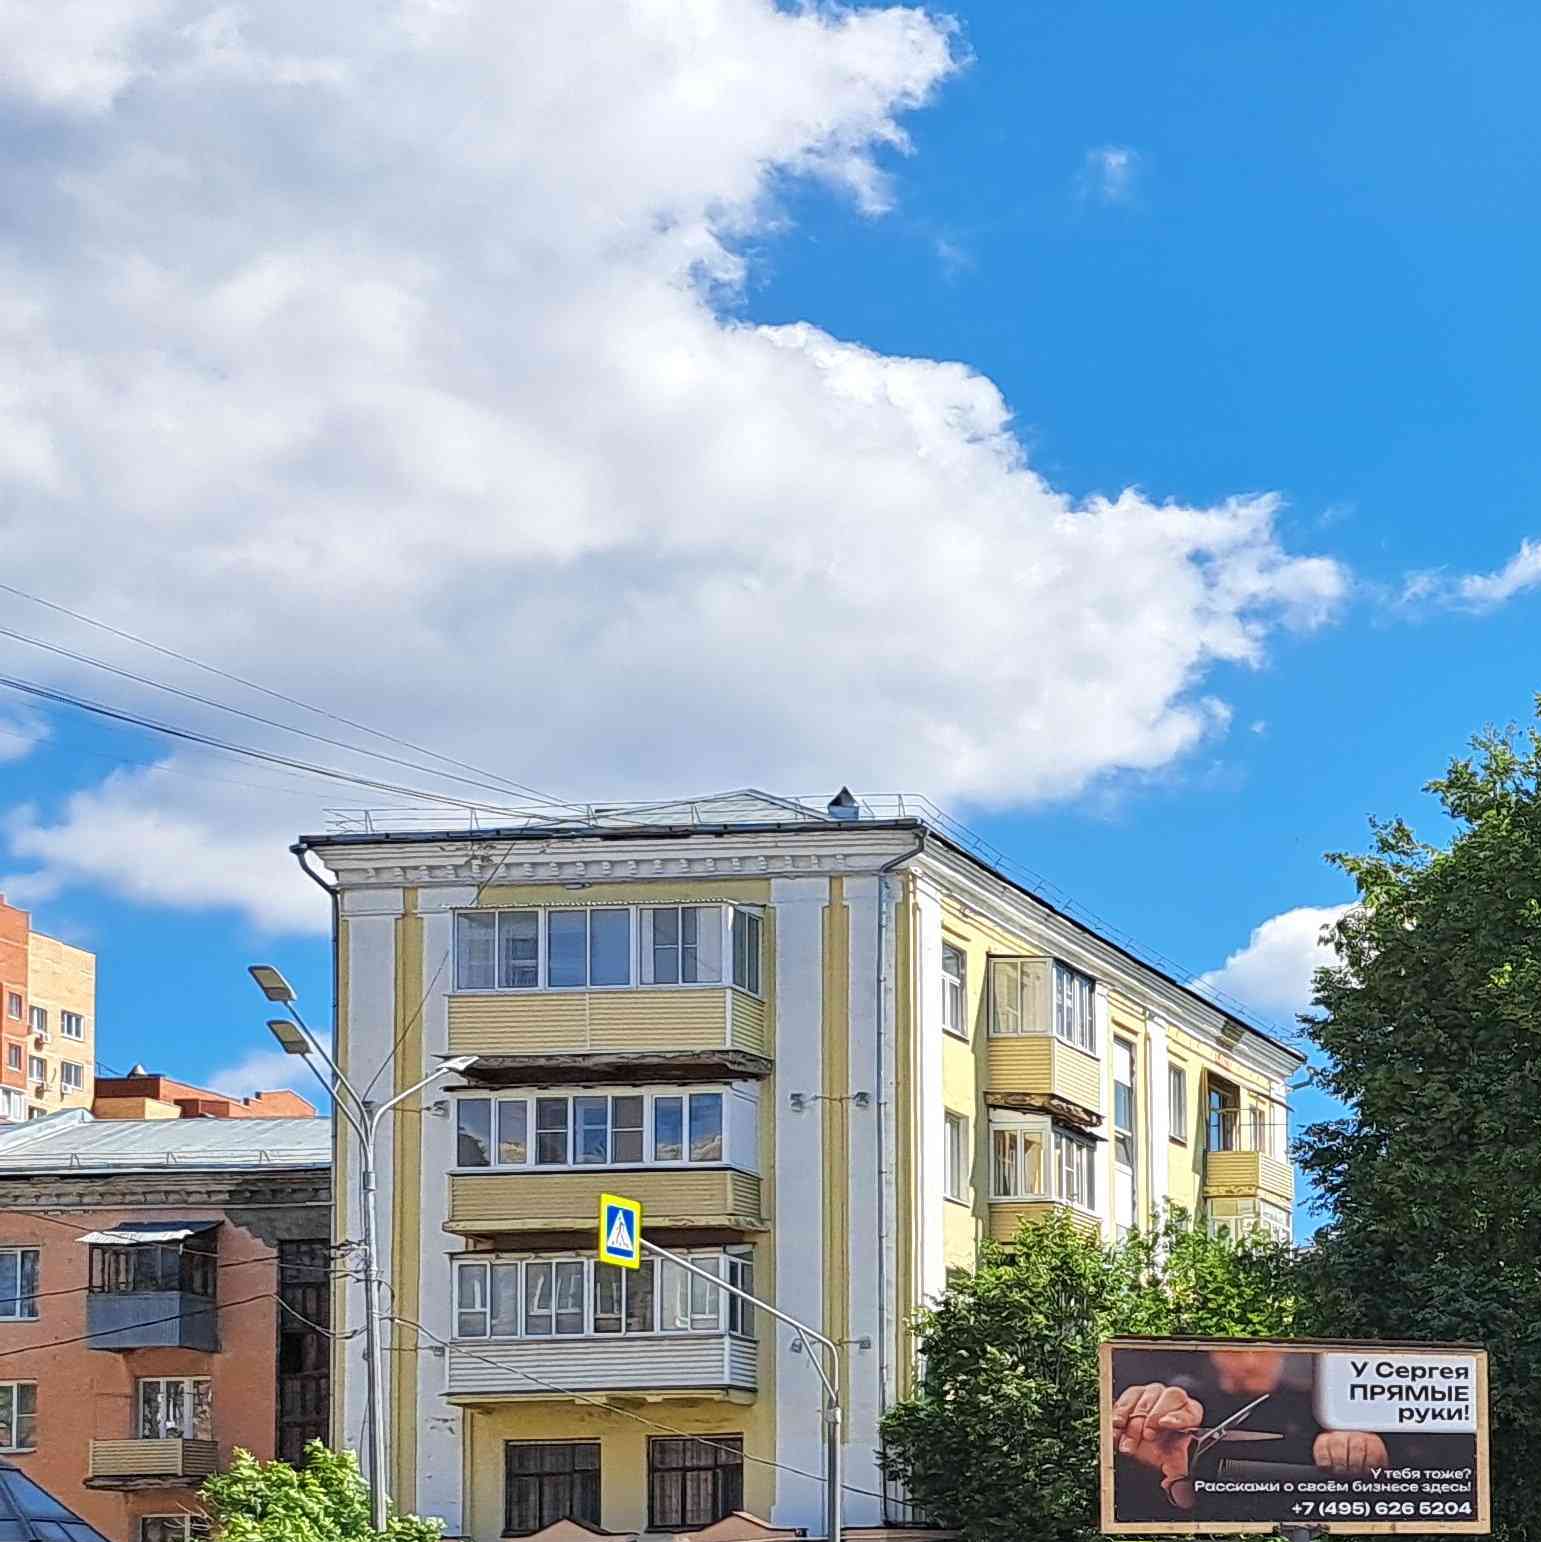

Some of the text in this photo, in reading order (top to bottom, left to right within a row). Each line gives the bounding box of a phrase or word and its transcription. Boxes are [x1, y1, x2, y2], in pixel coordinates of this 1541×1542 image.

[1351, 1361, 1469, 1382] У Сергея
[1350, 1383, 1469, 1402] ПРЯМЫЕ
[1399, 1405, 1469, 1423] руки!
[1371, 1468, 1472, 1480] У тебя тоже?
[1194, 1480, 1472, 1494] Расскажи о своём бизнесе здесь!
[1292, 1501, 1473, 1516] +7 (495) 626 5204
